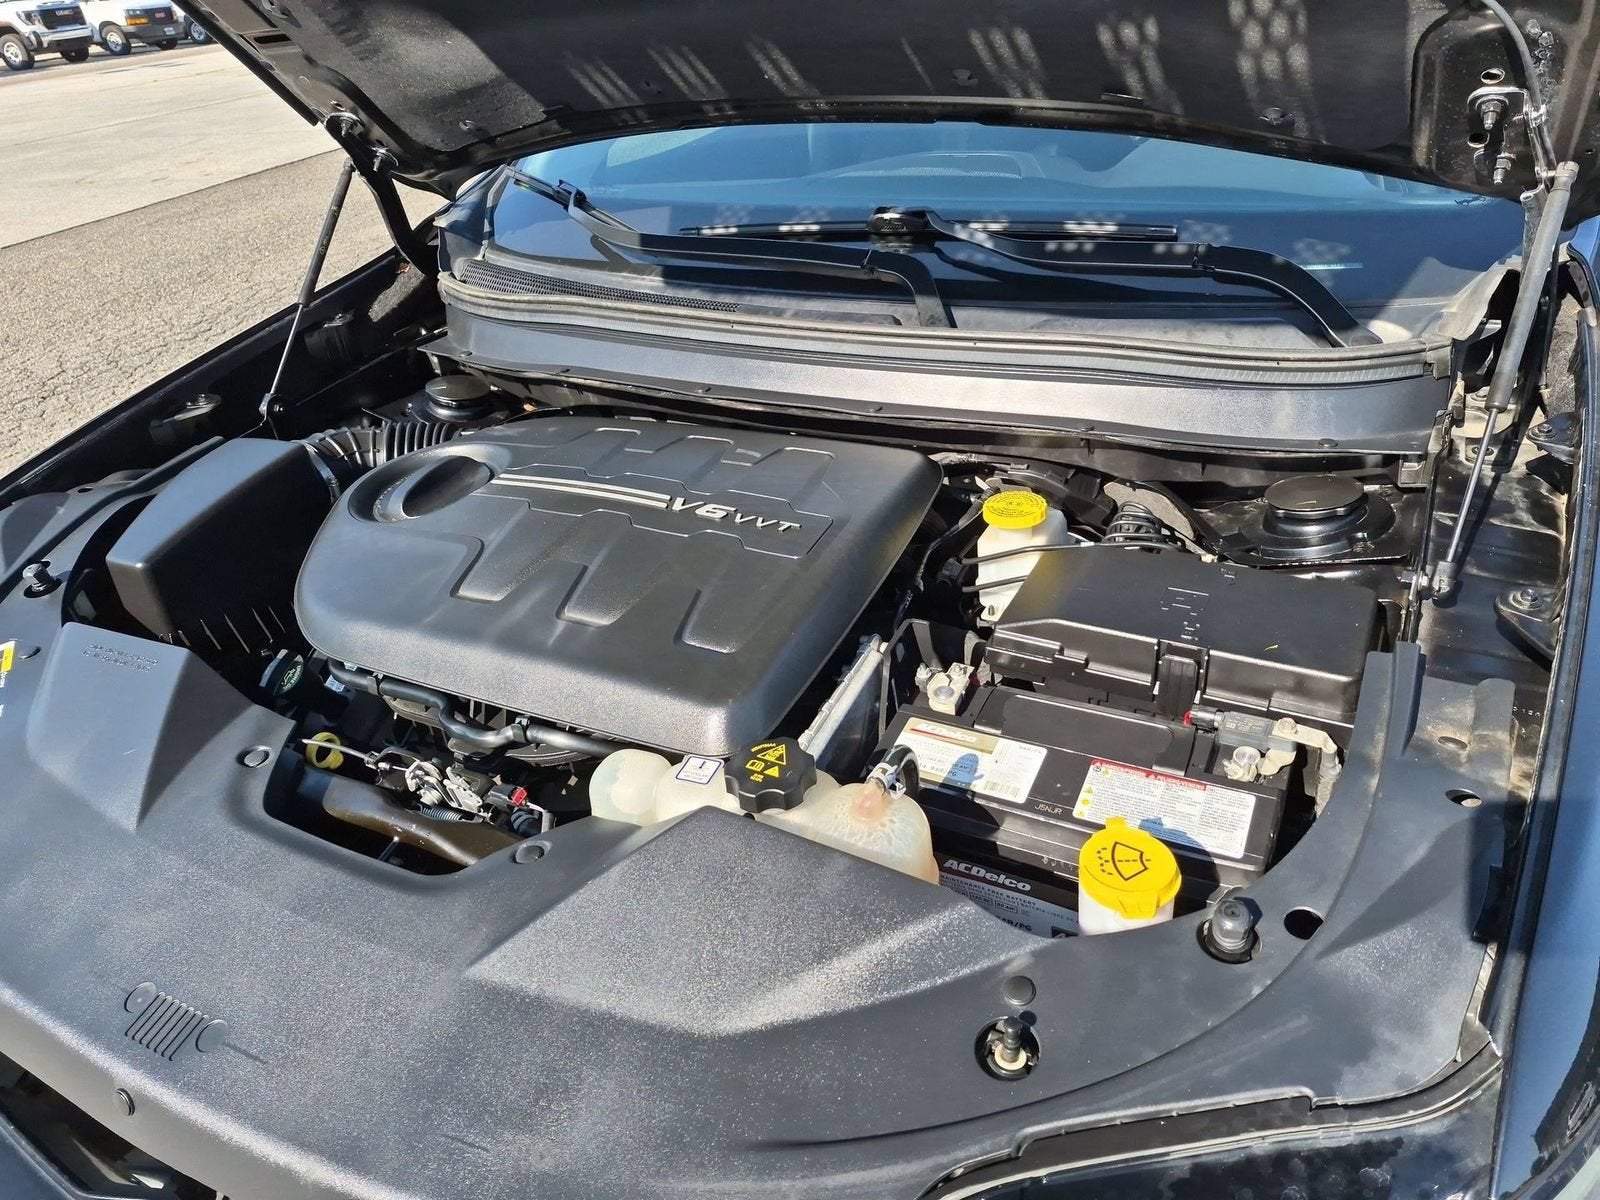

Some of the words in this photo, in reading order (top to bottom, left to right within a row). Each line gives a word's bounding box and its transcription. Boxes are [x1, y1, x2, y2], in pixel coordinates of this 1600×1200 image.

[672, 497, 737, 519] V6
[735, 513, 801, 532] VVT
[942, 859, 1032, 892] ACDelco
